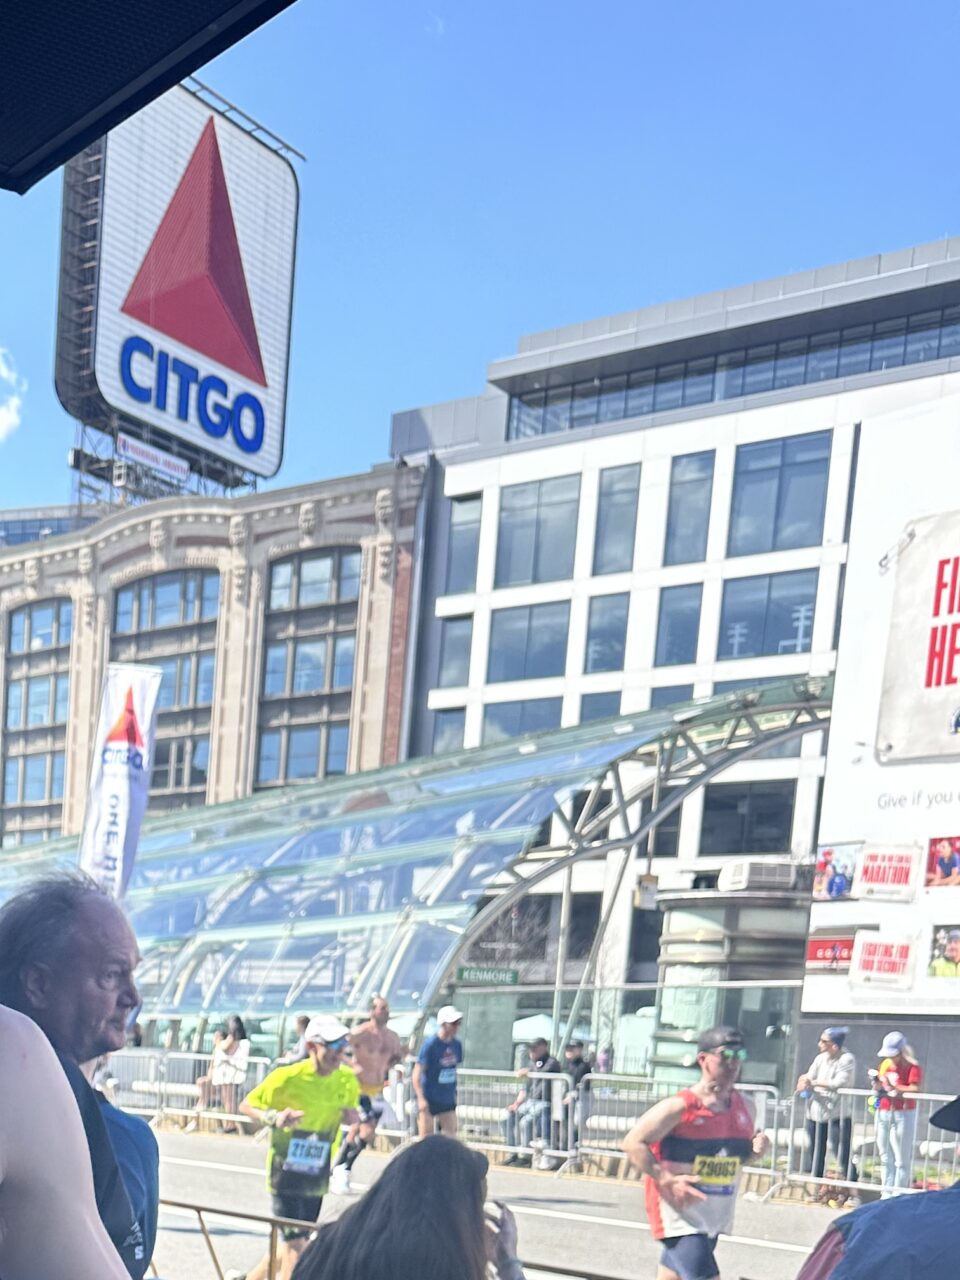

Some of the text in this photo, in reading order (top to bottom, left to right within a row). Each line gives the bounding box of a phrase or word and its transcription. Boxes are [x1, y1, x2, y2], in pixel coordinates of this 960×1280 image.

[119, 335, 265, 454] CITGO
[933, 555, 960, 617] FI
[877, 792, 908, 810] Give
[927, 791, 954, 809] you
[861, 865, 911, 886] MARATHON
[462, 967, 514, 983] KENMORE
